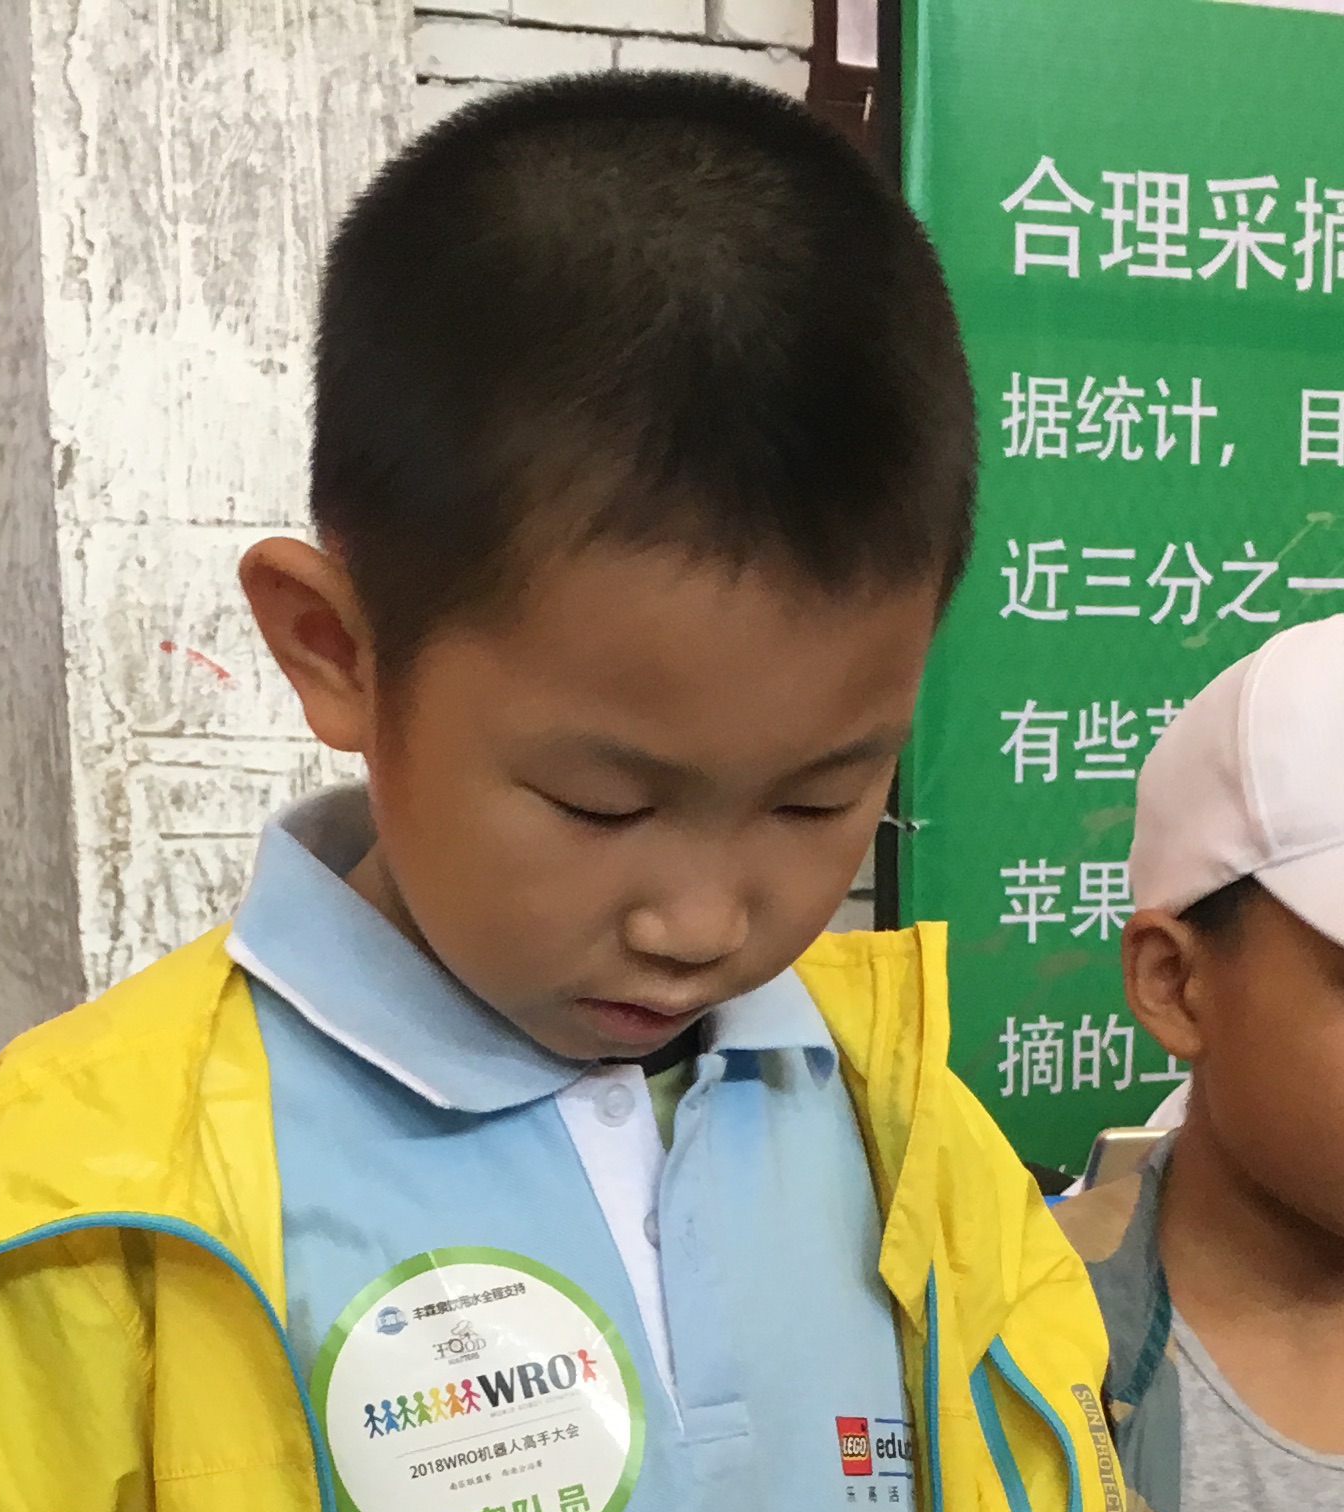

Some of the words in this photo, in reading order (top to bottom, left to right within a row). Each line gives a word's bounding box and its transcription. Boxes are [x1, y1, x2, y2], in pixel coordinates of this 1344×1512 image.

[999, 859, 1137, 944] 苹果
[477, 1353, 577, 1408] WRO
[1075, 1390, 1103, 1426] SUN
[409, 1423, 580, 1480] 2018WRO机器人高手大会
[842, 1436, 867, 1456] LEGO
